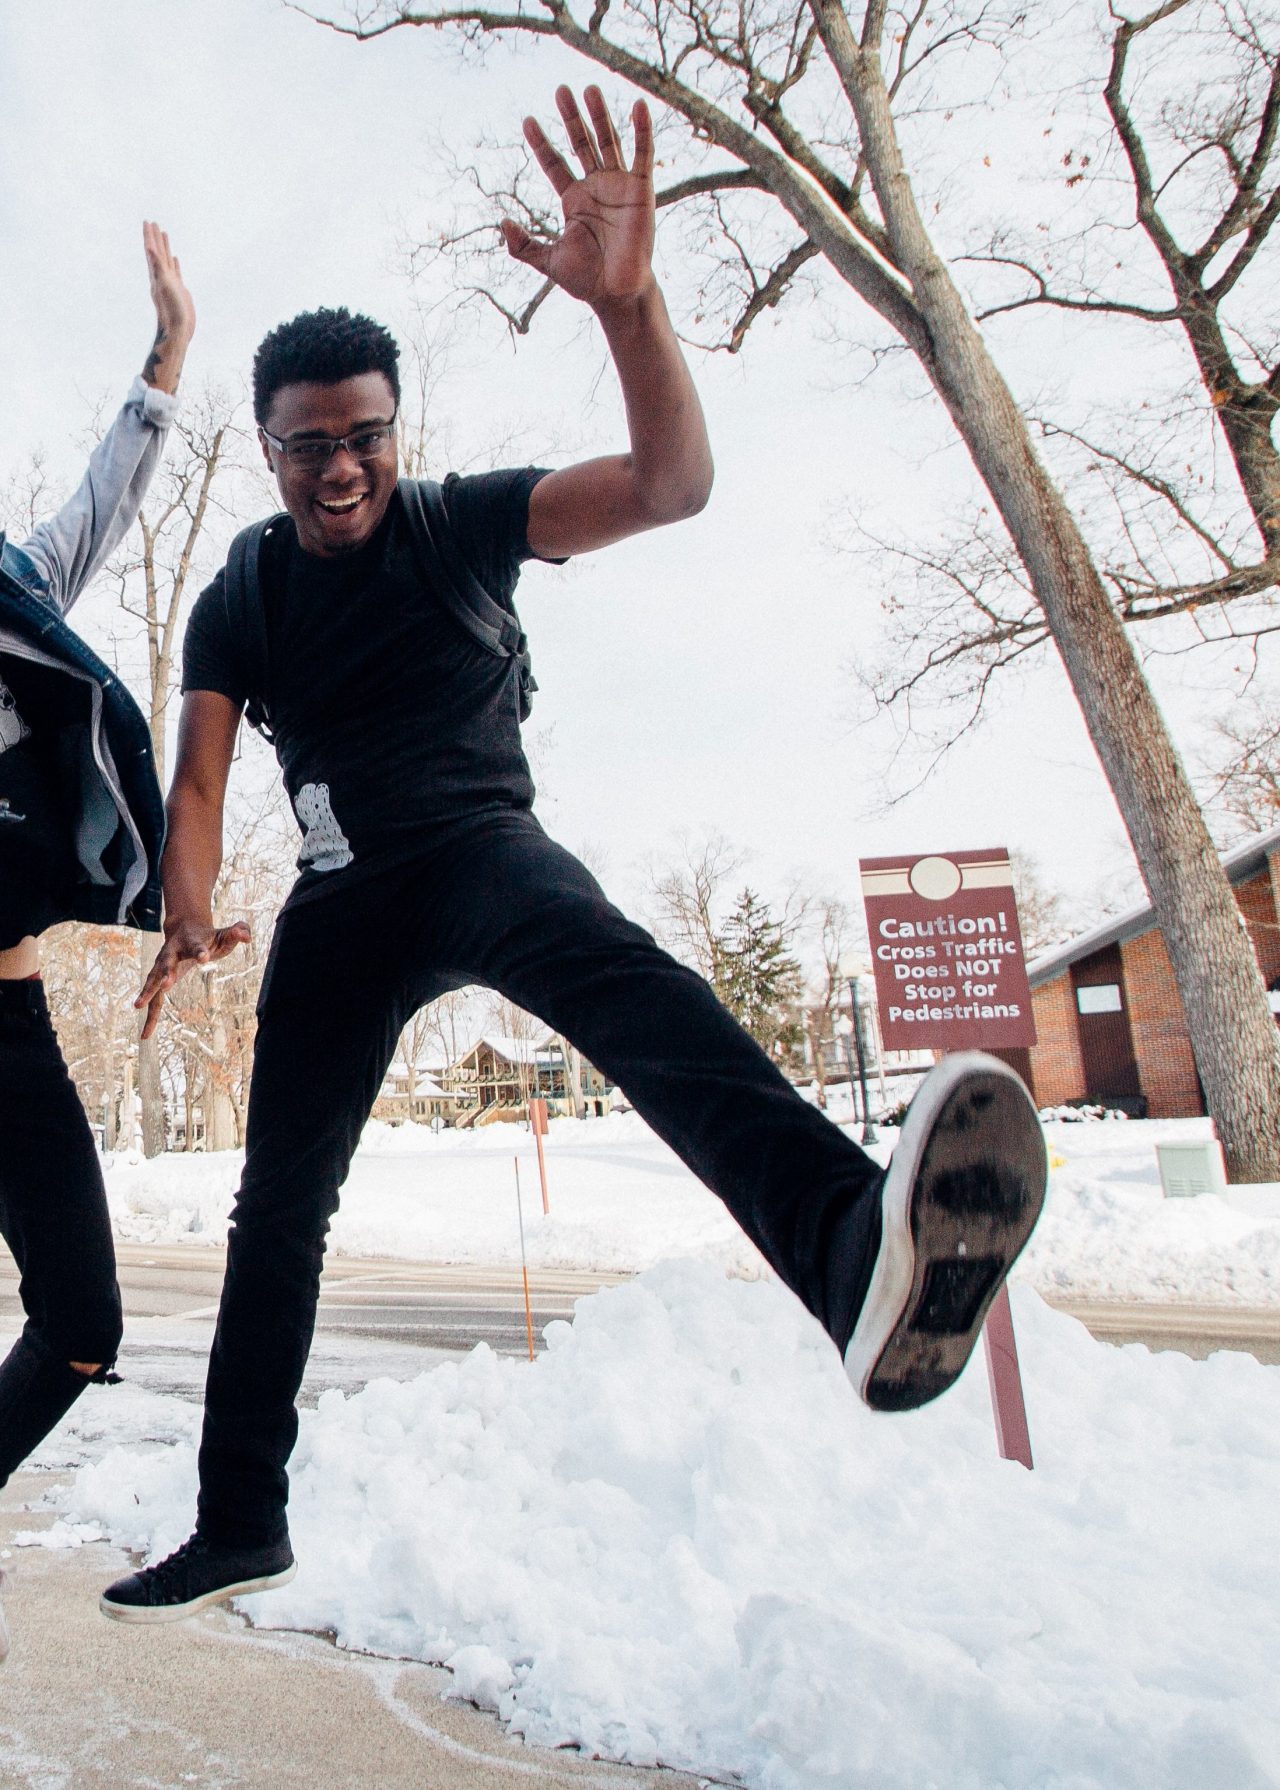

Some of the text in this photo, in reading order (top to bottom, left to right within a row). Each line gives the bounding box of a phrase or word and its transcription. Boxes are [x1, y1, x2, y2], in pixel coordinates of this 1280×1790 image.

[879, 912, 1007, 938] Caution!
[876, 938, 1017, 960] Cross Traffic
[894, 959, 1001, 980] Does NOT
[904, 981, 997, 1002] Stop for
[889, 1003, 1020, 1022] Pedestrians
